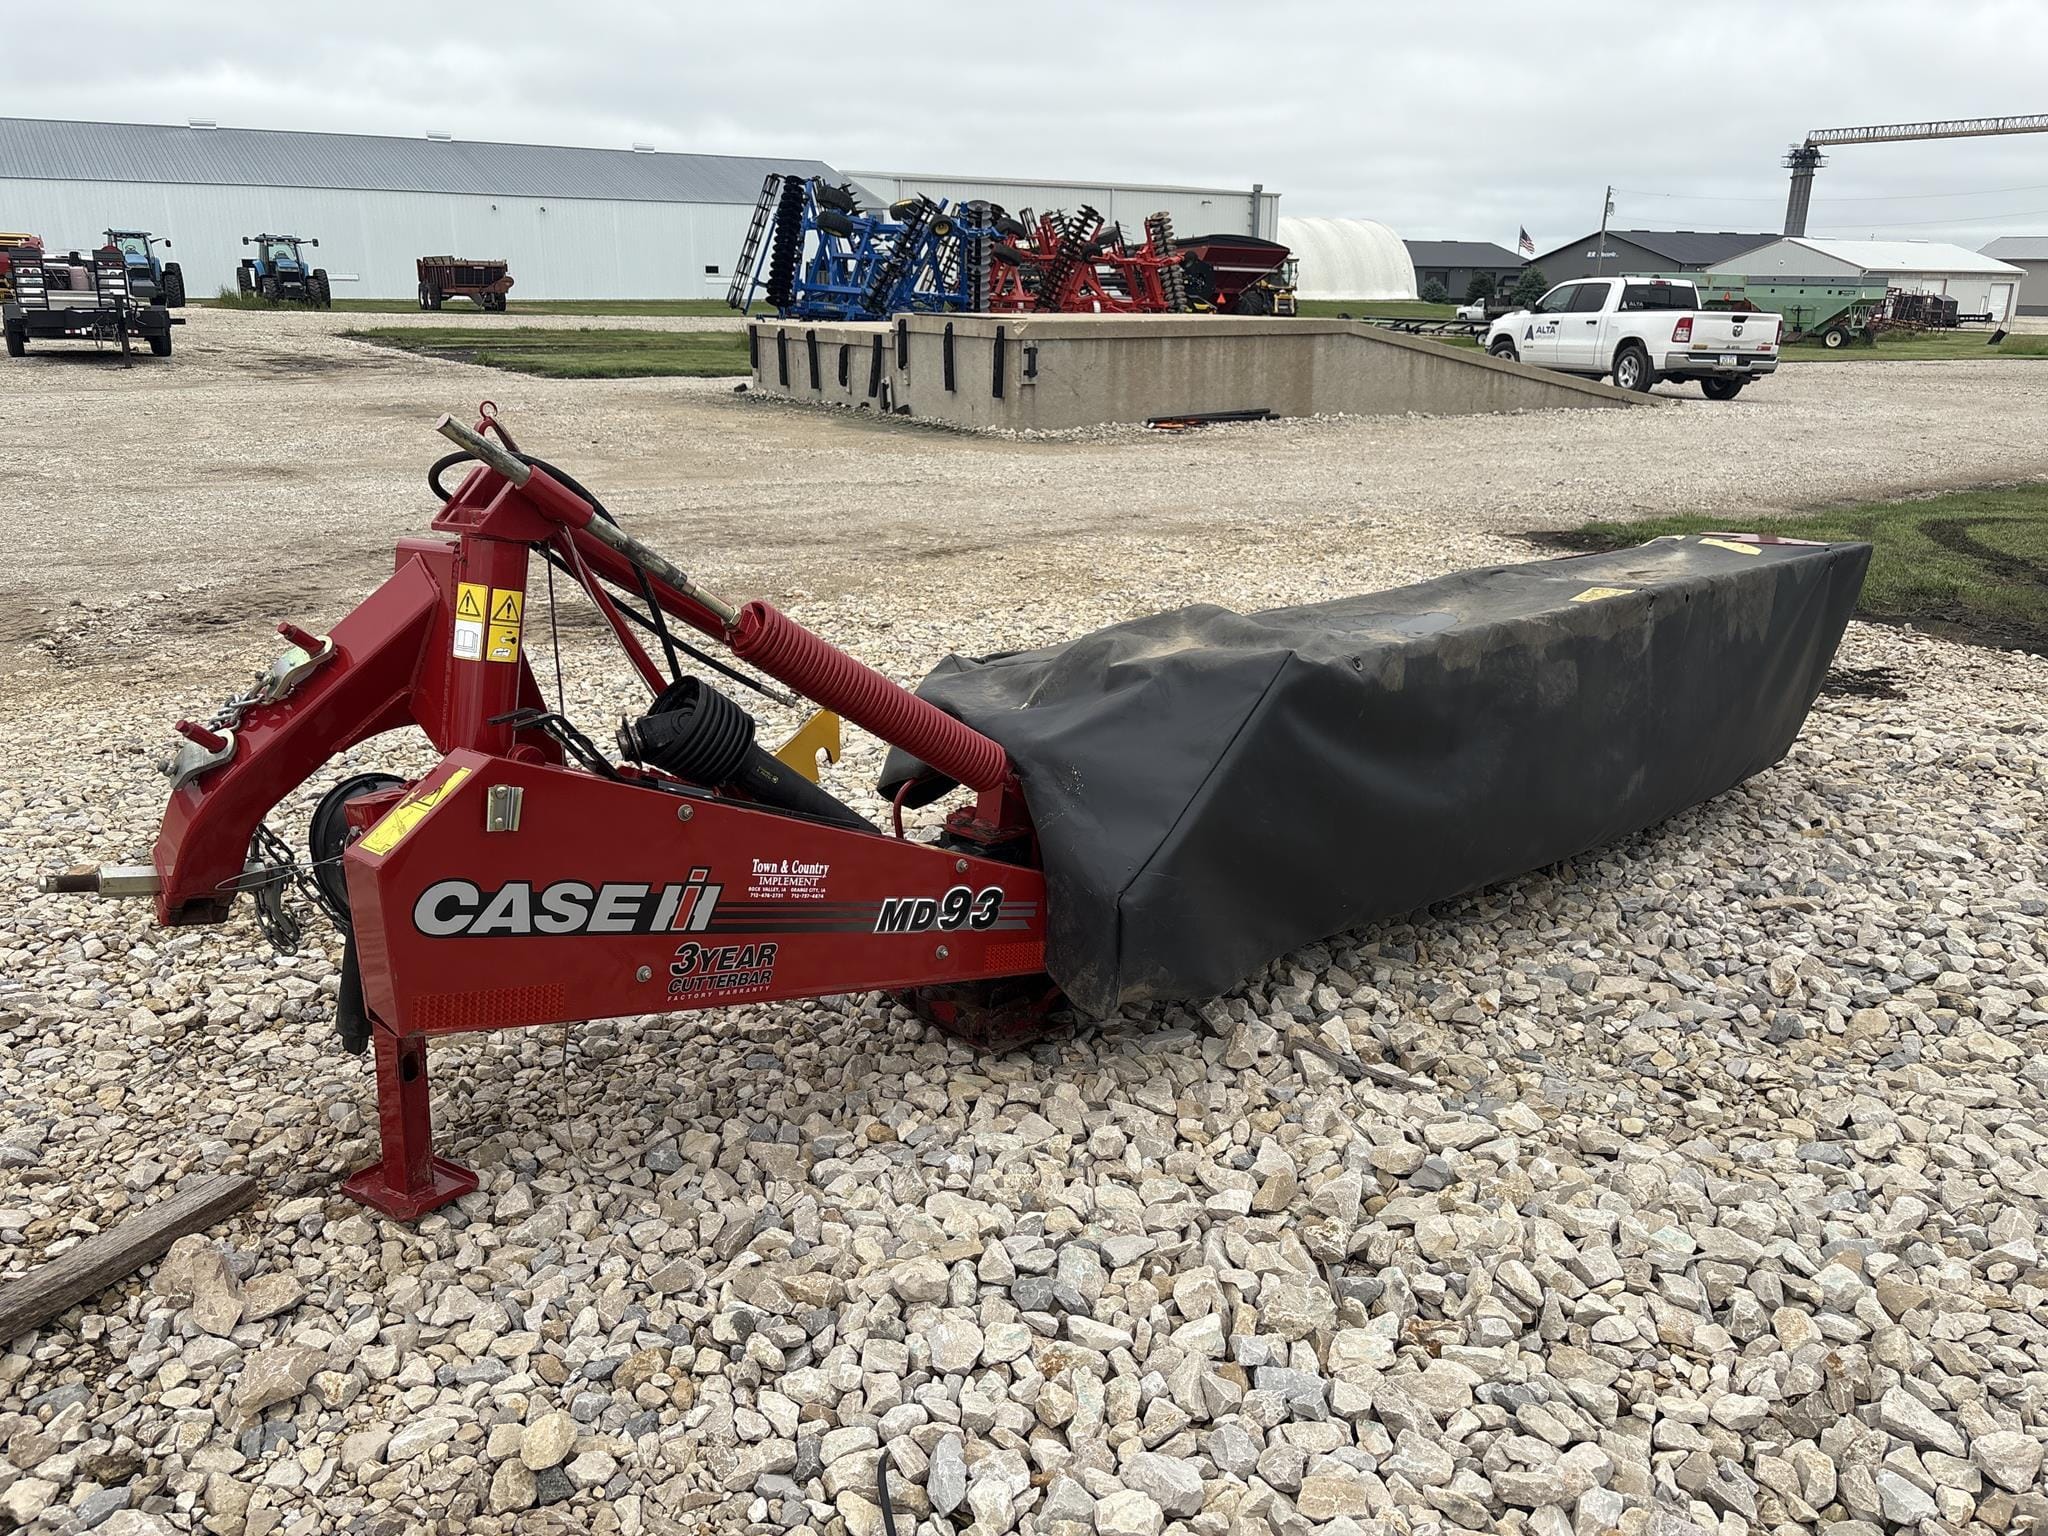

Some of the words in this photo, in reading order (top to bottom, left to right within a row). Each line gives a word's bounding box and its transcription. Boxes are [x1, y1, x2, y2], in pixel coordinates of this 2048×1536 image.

[1536, 326, 1556, 334] ALTA
[752, 858, 777, 873] Town
[780, 860, 788, 874] &
[792, 860, 830, 878] Country
[759, 876, 818, 886] IMPLEMENT
[414, 881, 649, 935] CASE
[668, 969, 773, 994] CUTTERBAR
[667, 991, 712, 1002] FACTORY
[718, 986, 770, 996] WARRANTY
